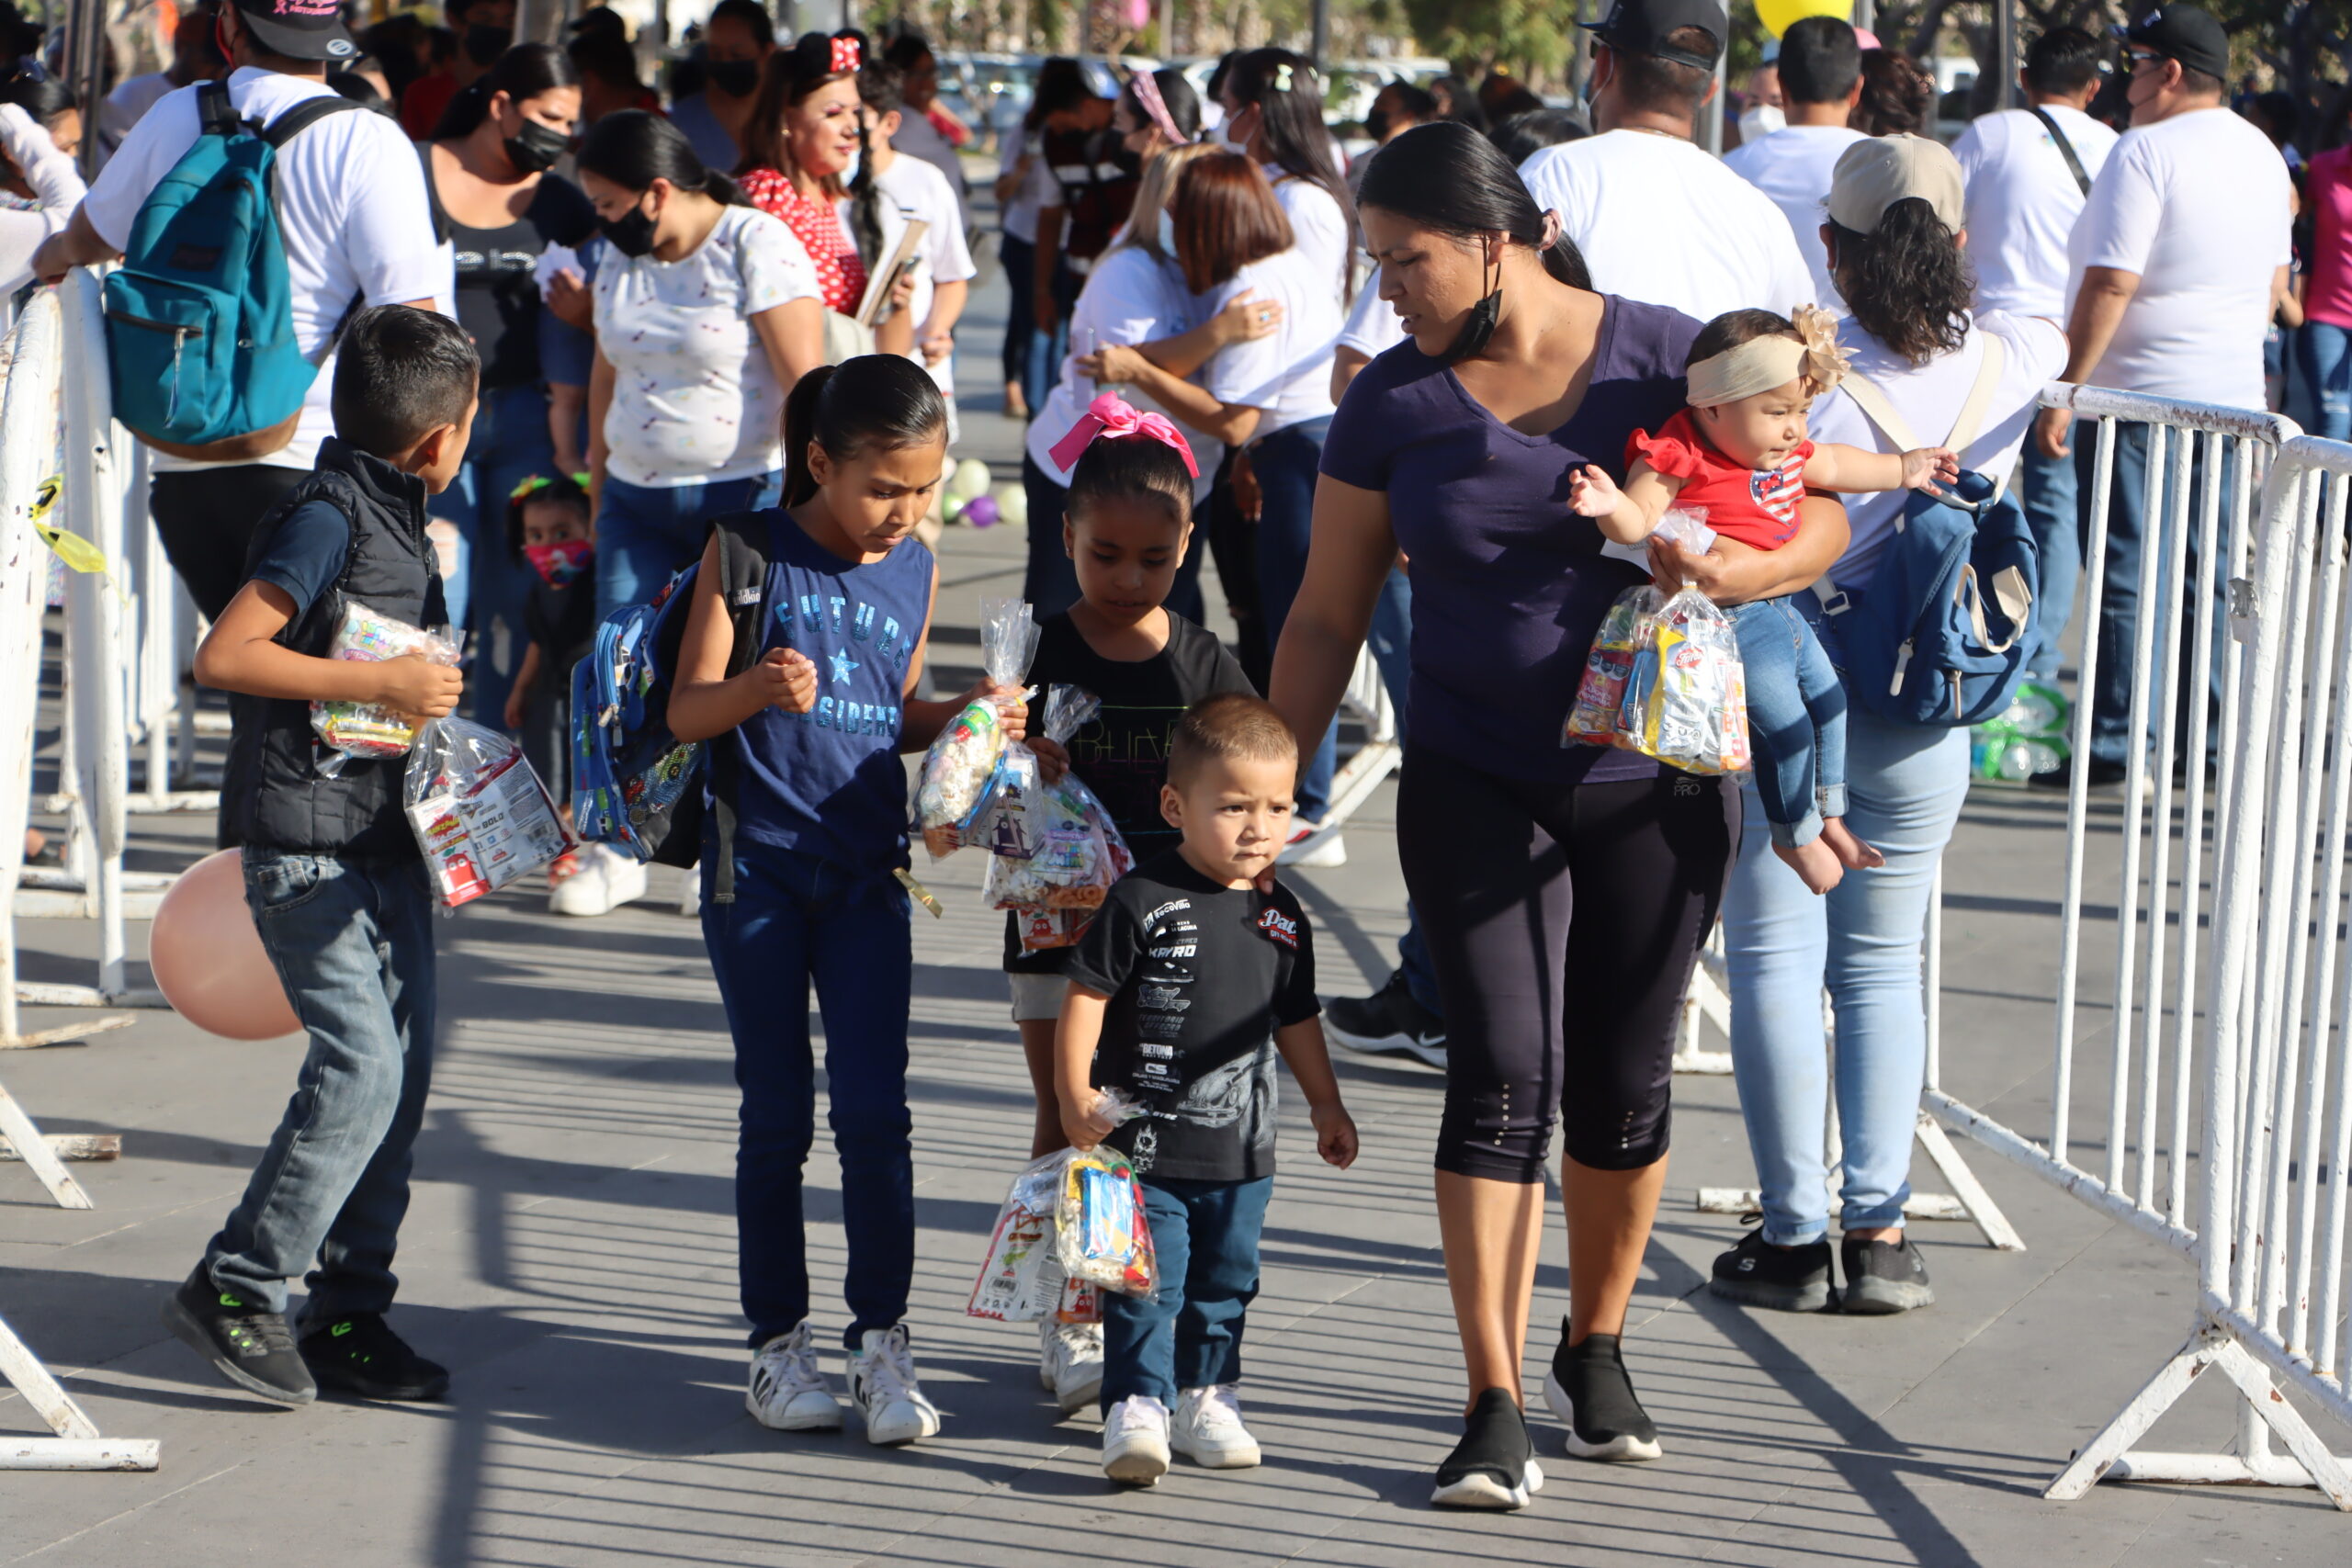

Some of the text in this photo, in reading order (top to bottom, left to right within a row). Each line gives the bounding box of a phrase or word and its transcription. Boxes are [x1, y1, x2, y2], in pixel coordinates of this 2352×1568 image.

[763, 695, 898, 738] SIDENT
[1674, 784, 1701, 796] PRO
[481, 812, 504, 829] BOLD
